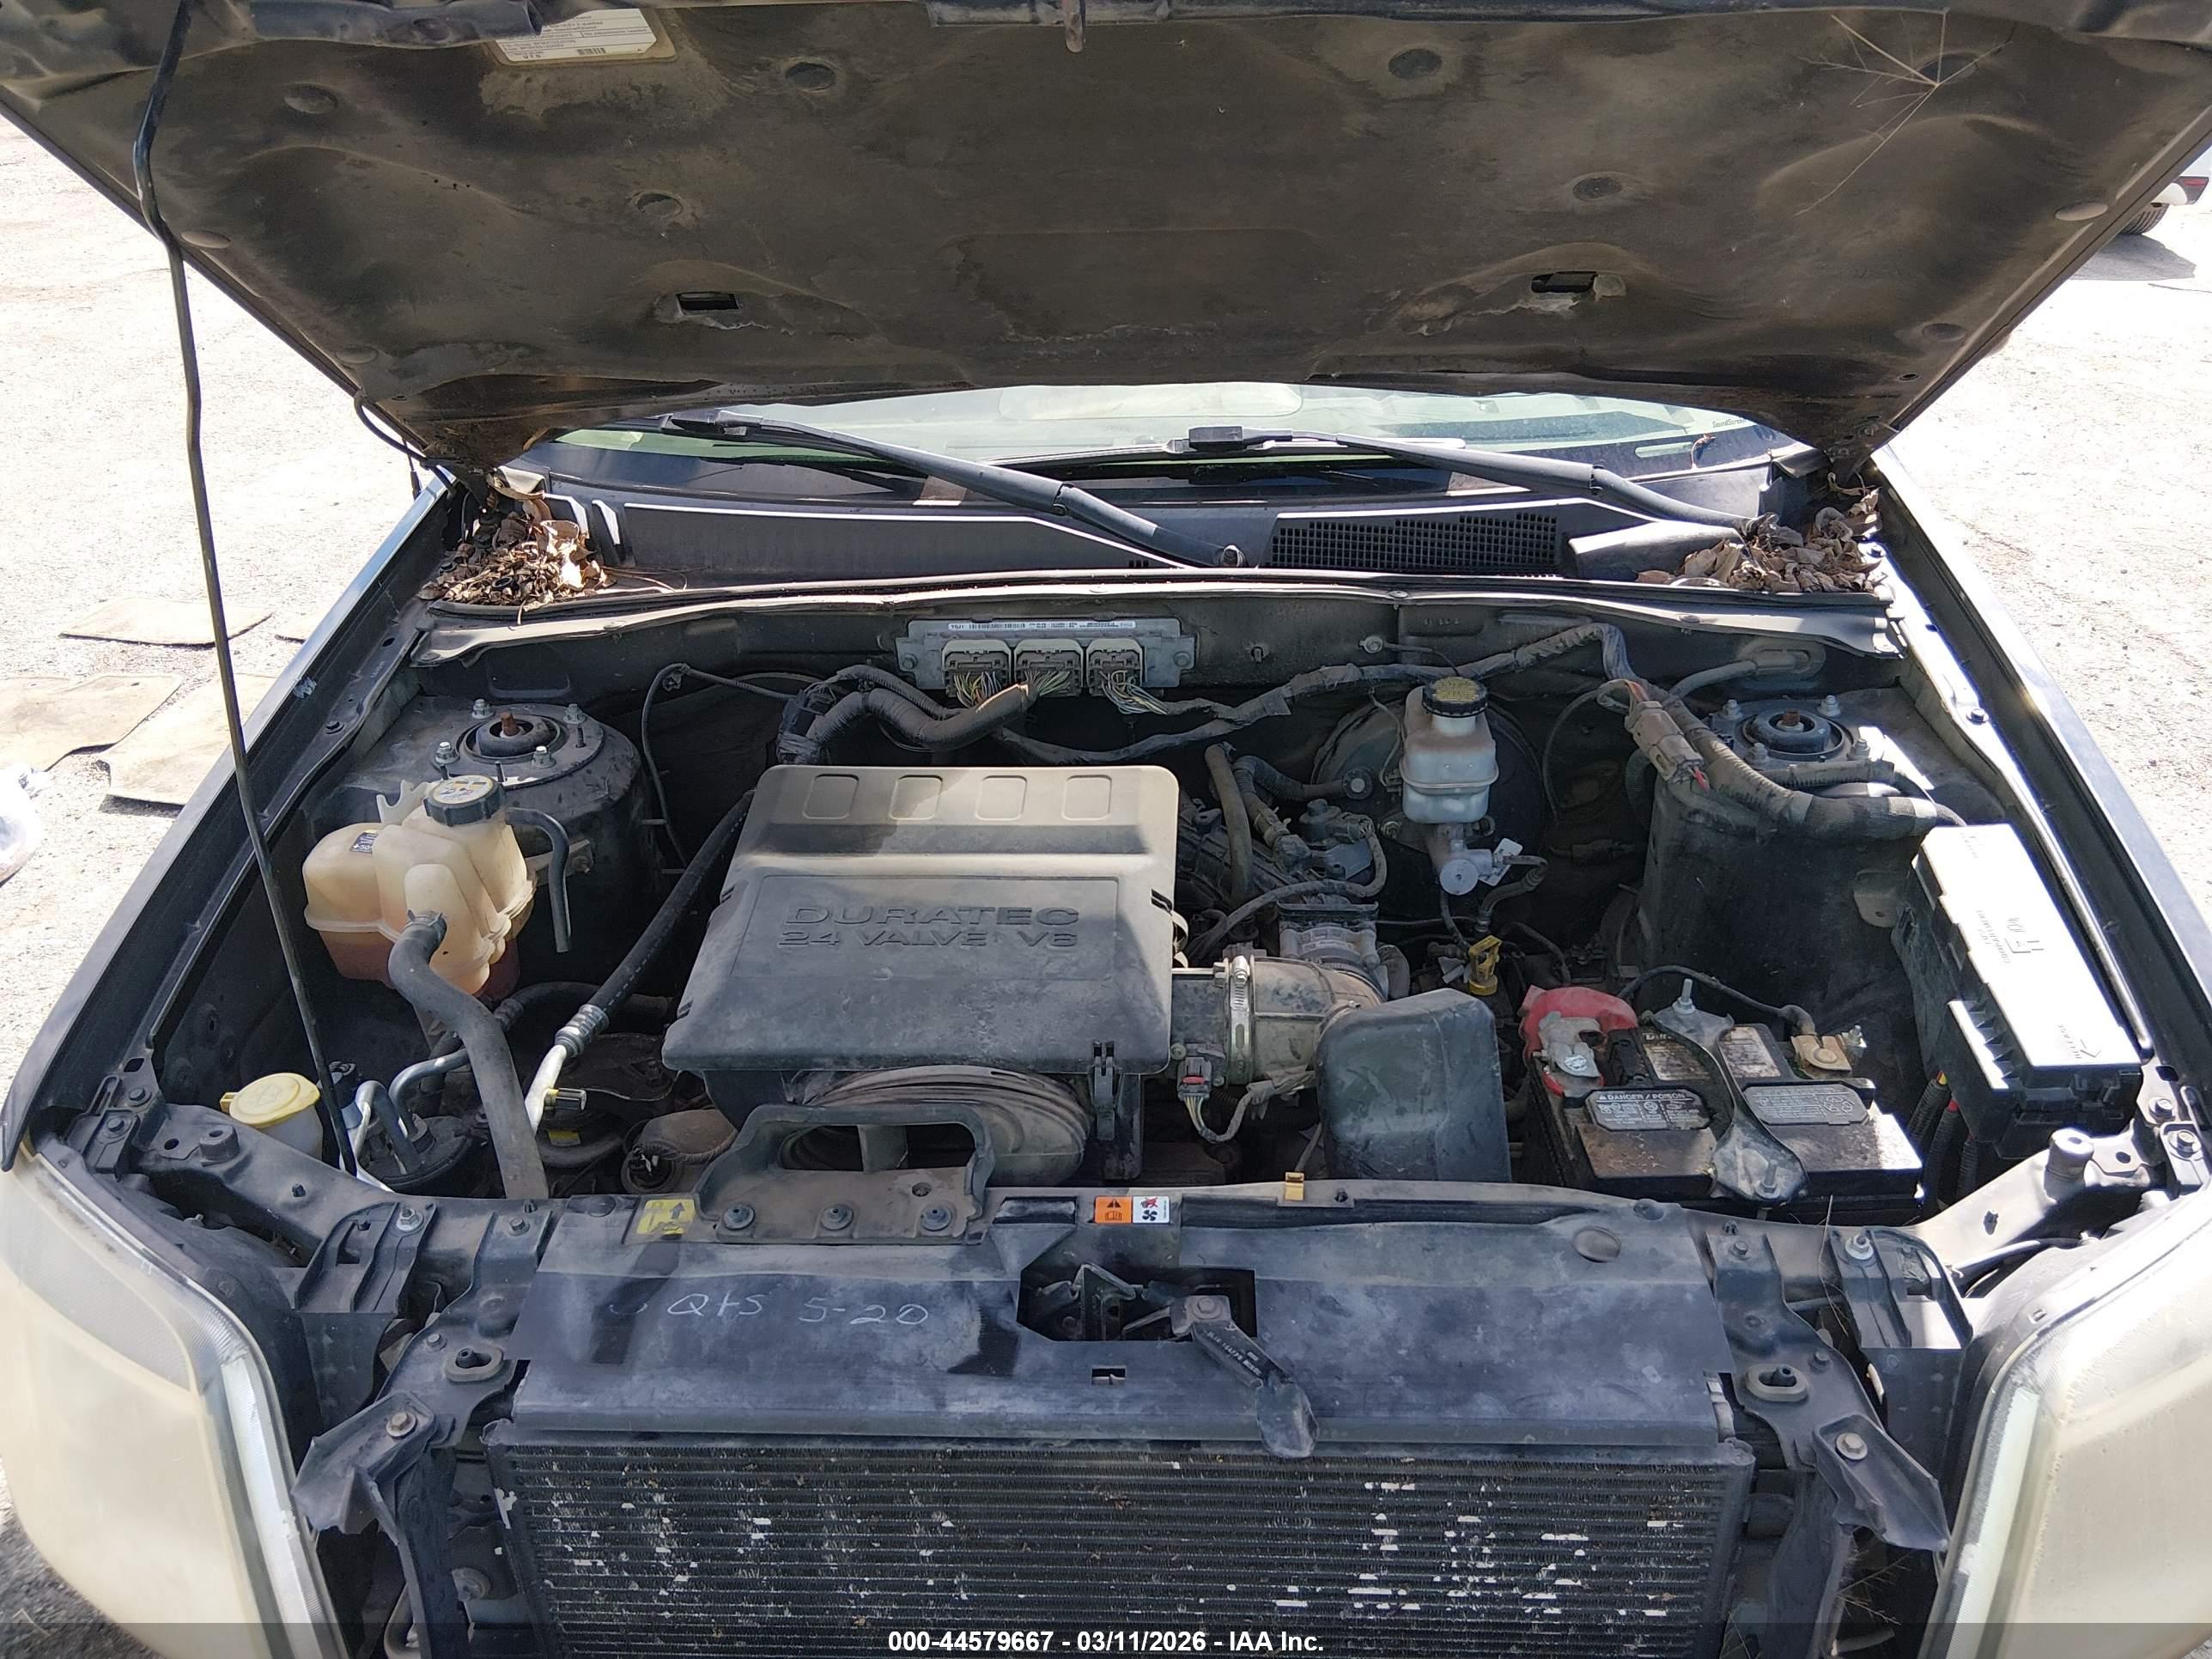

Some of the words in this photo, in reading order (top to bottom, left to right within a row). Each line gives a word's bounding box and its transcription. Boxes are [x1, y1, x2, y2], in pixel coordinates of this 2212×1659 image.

[784, 905, 1079, 927] DURATEC
[777, 929, 841, 947] 24
[859, 928, 988, 947] VALVE
[1016, 929, 1079, 948] V6
[798, 1297, 929, 1325] 5-20
